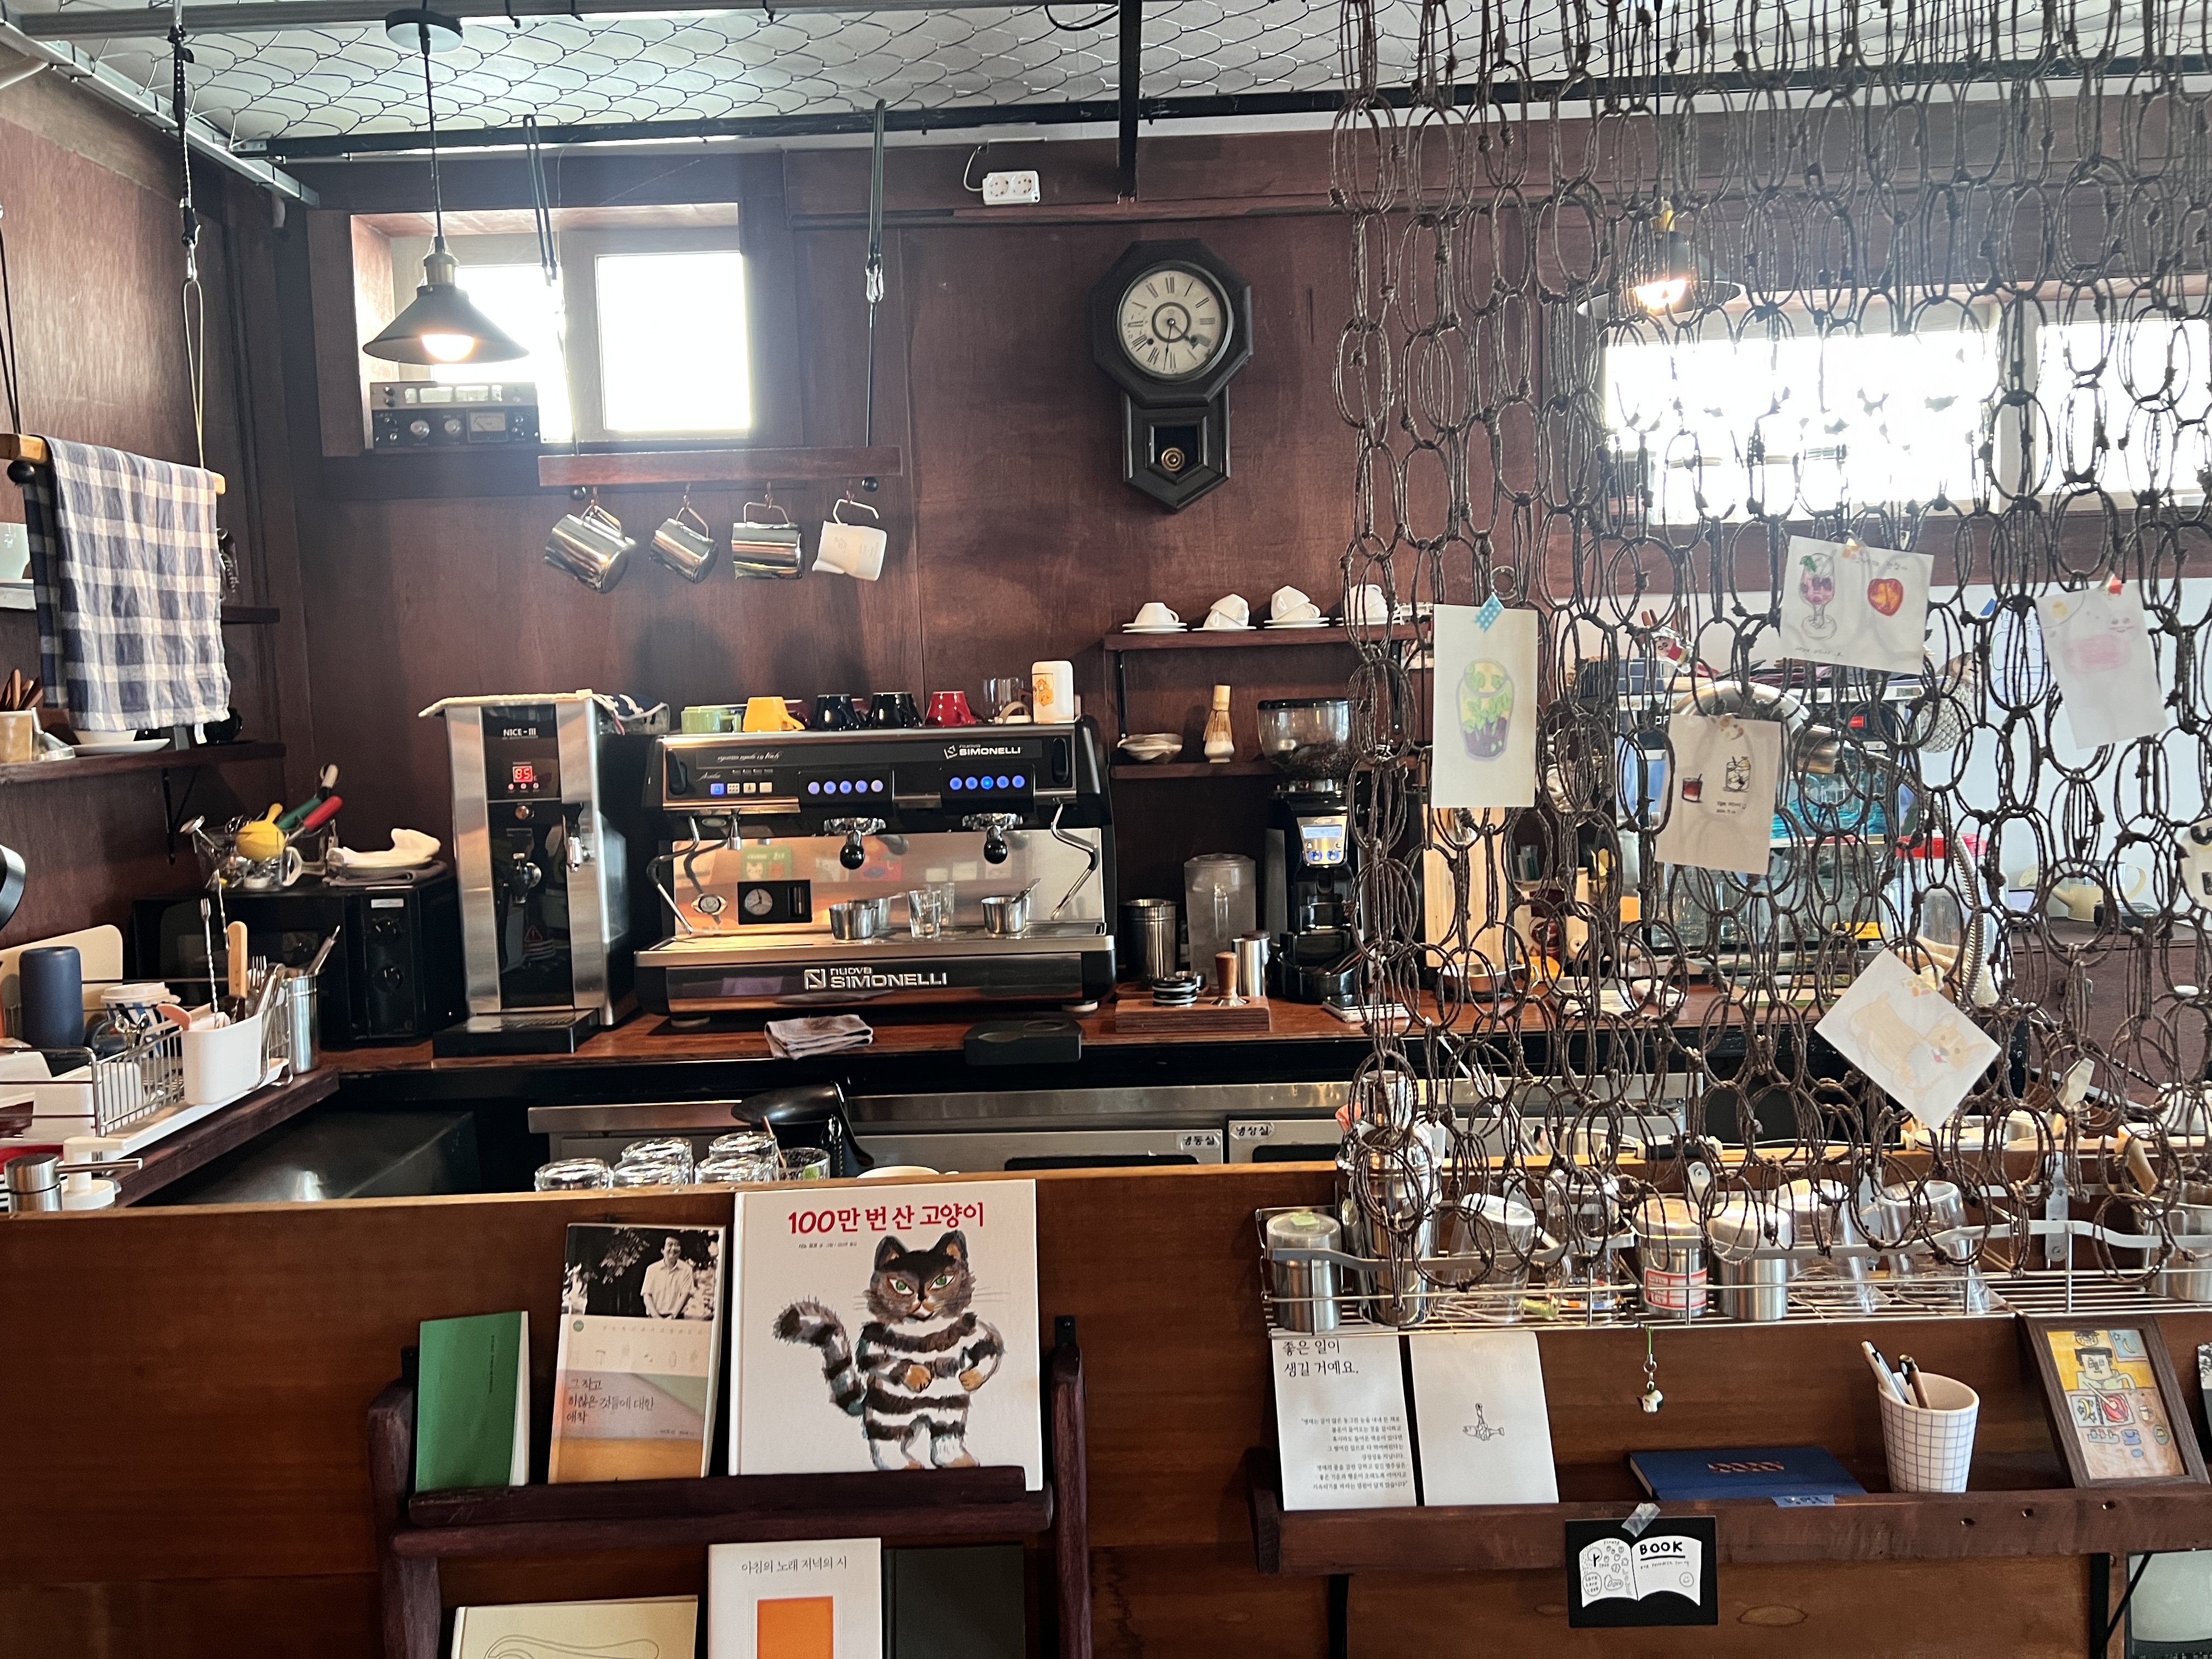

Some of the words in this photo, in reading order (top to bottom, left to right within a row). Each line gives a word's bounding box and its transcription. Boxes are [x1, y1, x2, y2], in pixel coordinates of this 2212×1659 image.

[959, 746, 1021, 756] SIMONELLI
[515, 767, 531, 780] 85
[830, 967, 872, 976] nuova
[830, 972, 947, 989] SIMONELLI
[788, 1207, 861, 1234] 100만
[865, 1206, 887, 1232] 번
[891, 1204, 915, 1231] 산
[919, 1201, 985, 1228] 고양이
[1283, 1340, 1310, 1357] 좋은
[1314, 1338, 1340, 1355] 일이
[1284, 1361, 1310, 1378] 생길
[1639, 1540, 1683, 1555] BOOK
[741, 1559, 773, 1575] 아침의
[776, 1558, 798, 1572] 노래
[801, 1556, 833, 1572] 저녁의
[836, 1555, 847, 1570] 시
